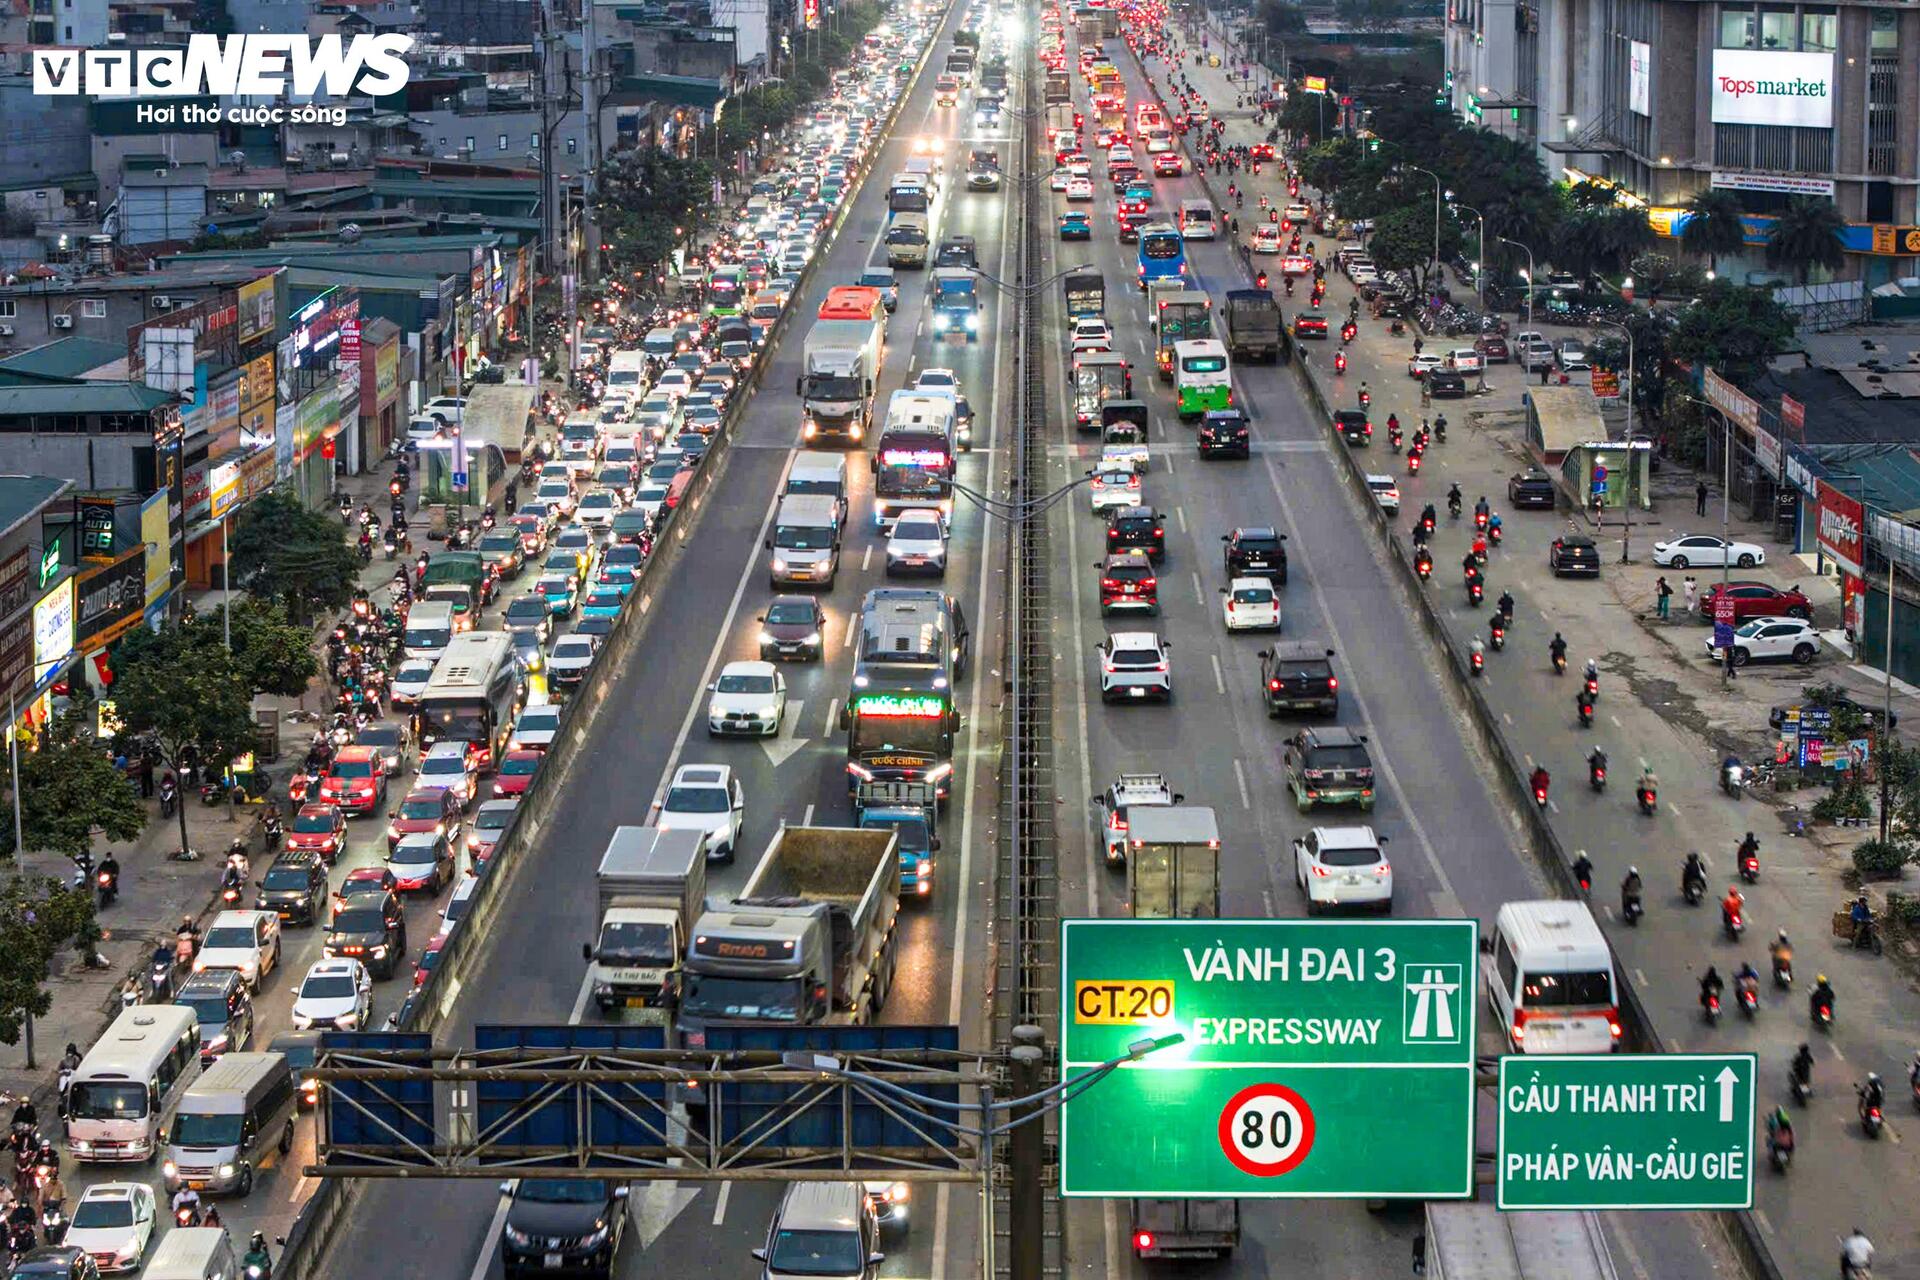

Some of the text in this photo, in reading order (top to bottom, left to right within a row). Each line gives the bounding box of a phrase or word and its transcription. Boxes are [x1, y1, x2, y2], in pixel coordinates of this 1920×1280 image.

[1718, 76, 1827, 98] Tops market
[84, 519, 112, 530] AUTO
[82, 587, 109, 619] AUTO
[871, 755, 896, 765] QUỐC
[1183, 939, 1397, 983] VÀNH ĐAI 3
[1077, 985, 1171, 1018] CT.20
[1193, 1017, 1383, 1045] EXPRESSWAY
[1508, 1070, 1706, 1114] CẦU THANH TRÌ
[1240, 1109, 1293, 1149] 80
[1506, 1143, 1580, 1181] PHÁP
[1701, 1145, 1745, 1181] GIẼ
